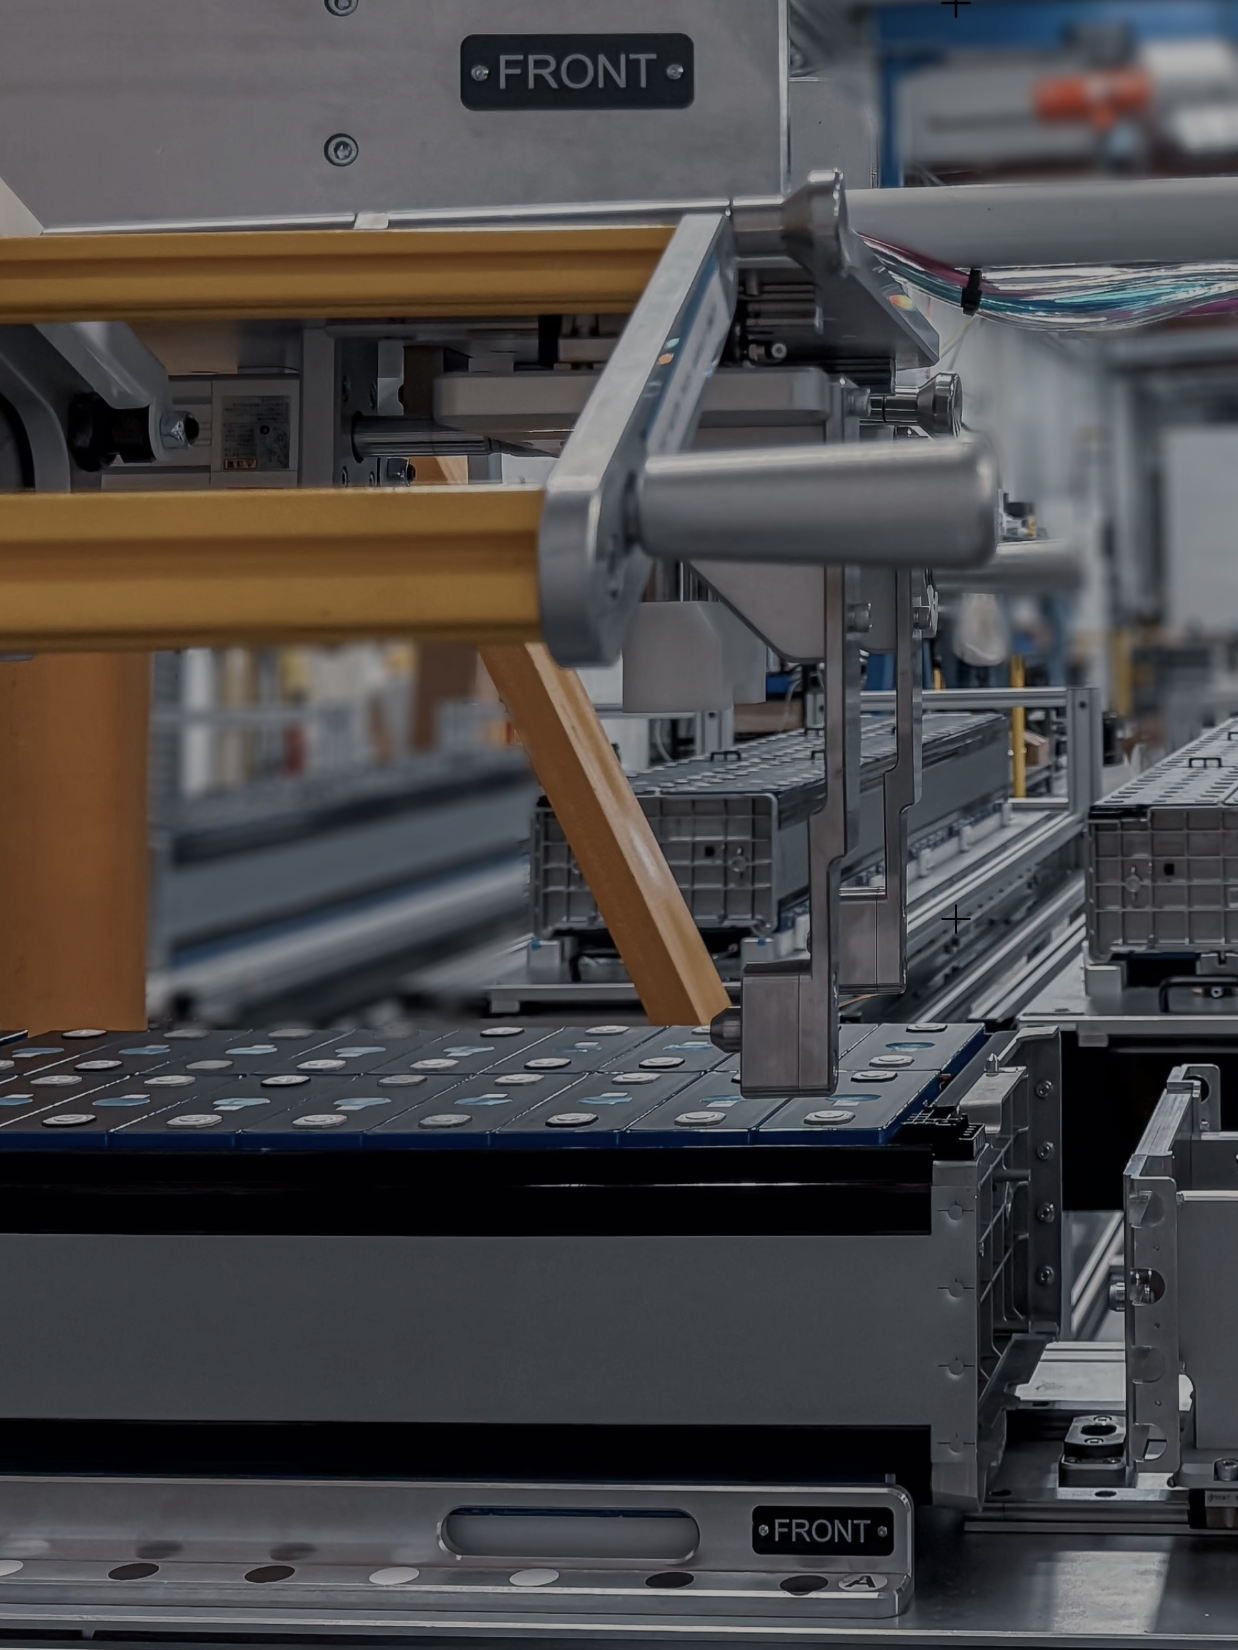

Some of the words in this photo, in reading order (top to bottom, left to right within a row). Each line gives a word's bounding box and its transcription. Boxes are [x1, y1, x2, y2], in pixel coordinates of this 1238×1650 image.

[499, 53, 658, 90] FRONT
[774, 1518, 871, 1543] FRONT
[845, 1575, 876, 1588] A
